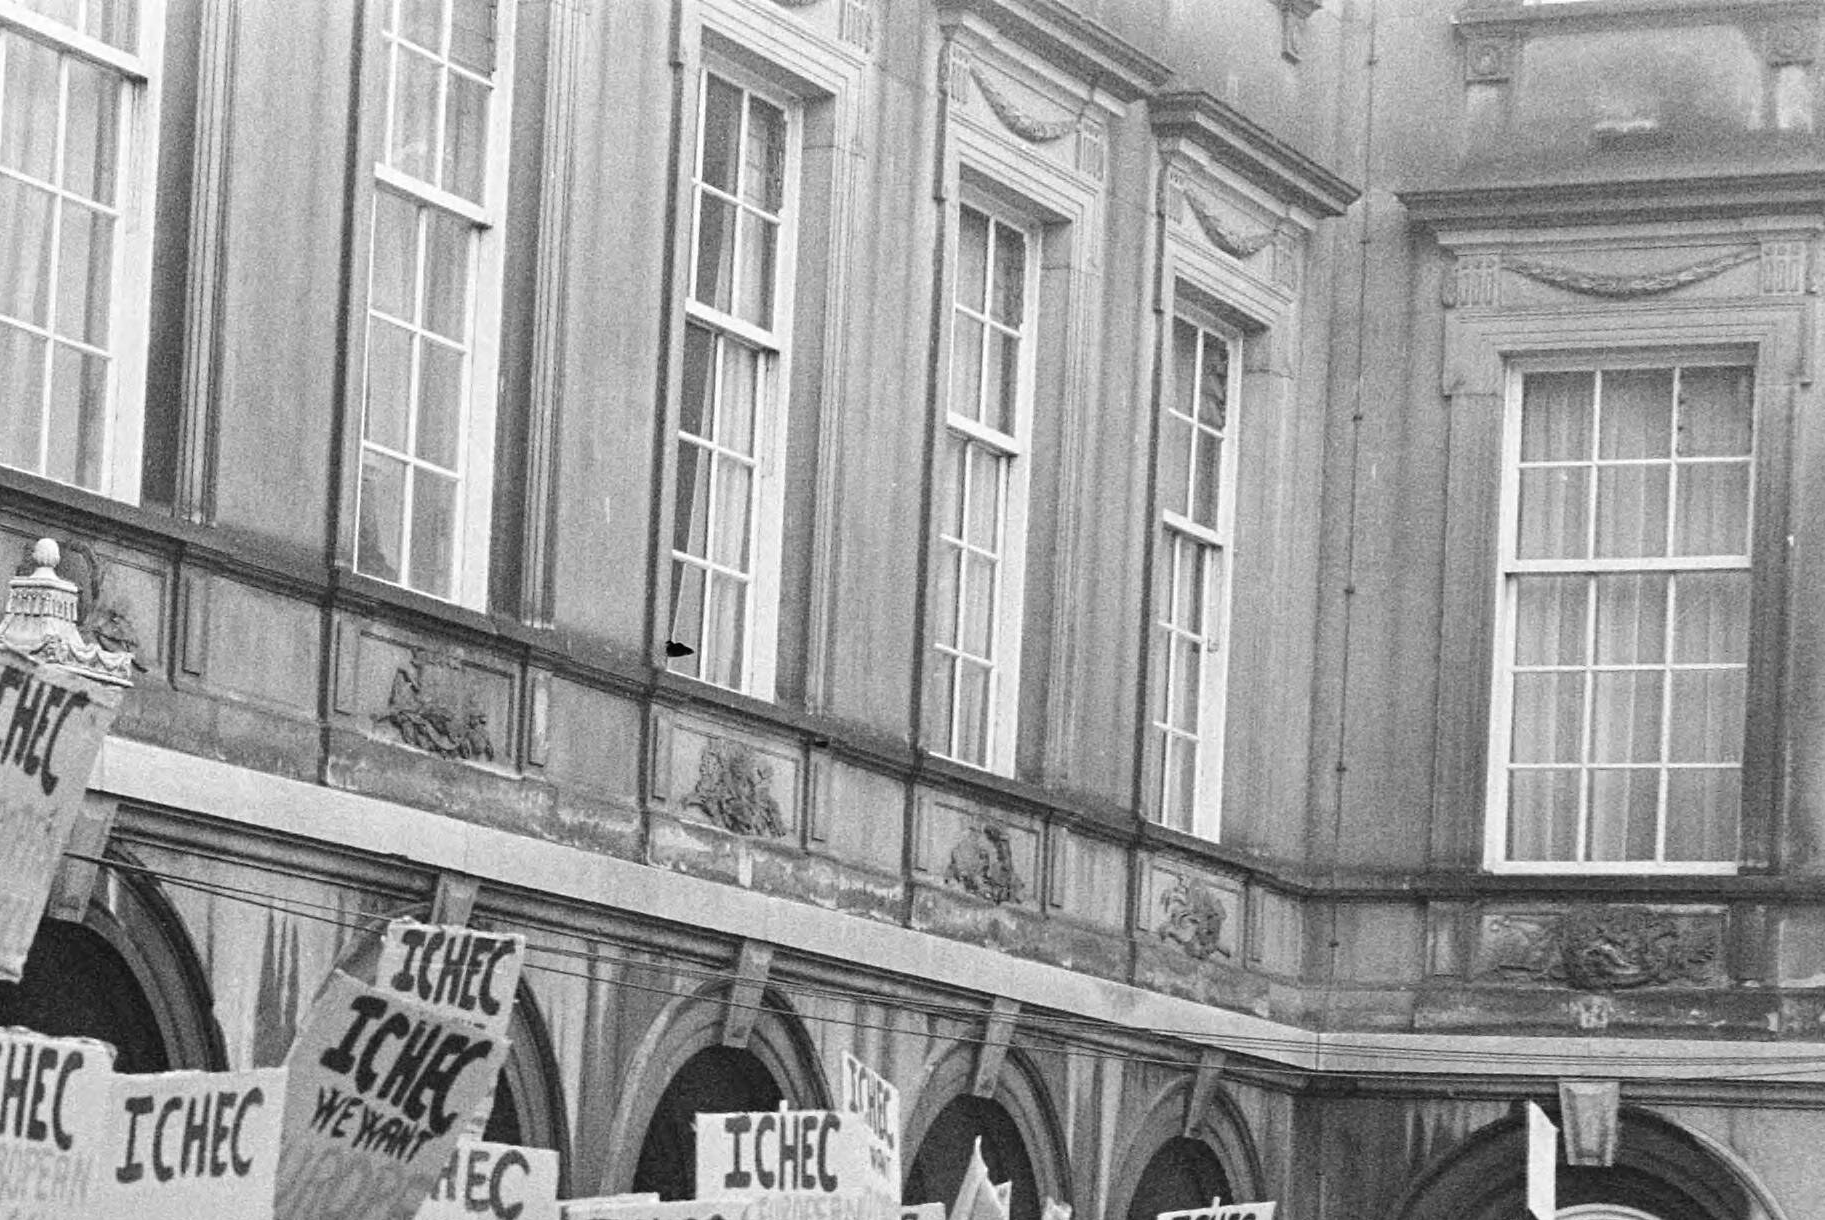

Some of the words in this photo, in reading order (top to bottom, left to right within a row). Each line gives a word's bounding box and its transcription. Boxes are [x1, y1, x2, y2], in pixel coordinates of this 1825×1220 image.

[391, 929, 516, 1016] ICHEC
[319, 995, 494, 1136] ICHEC
[116, 1086, 264, 1183] ICHEC
[310, 1087, 364, 1138] WE
[351, 1105, 435, 1163] WANT
[723, 1115, 841, 1192] ICHEC
